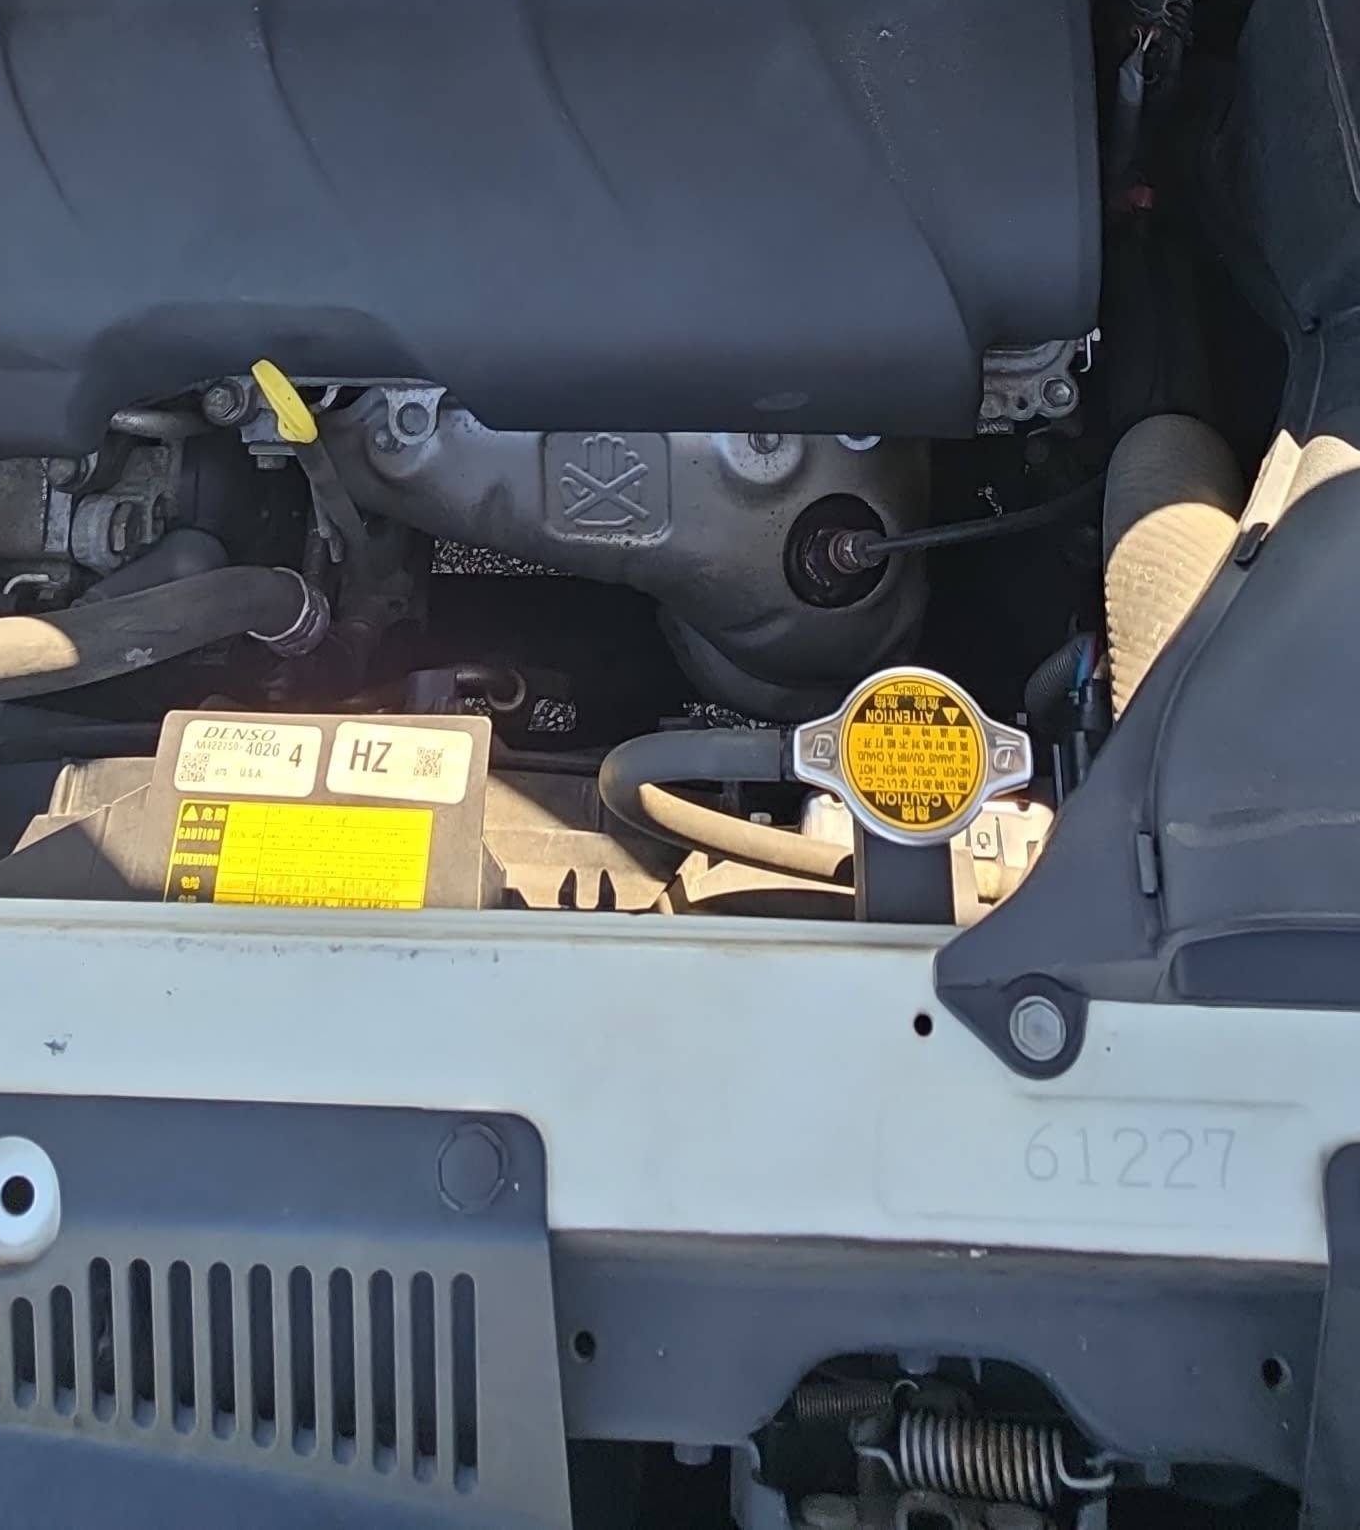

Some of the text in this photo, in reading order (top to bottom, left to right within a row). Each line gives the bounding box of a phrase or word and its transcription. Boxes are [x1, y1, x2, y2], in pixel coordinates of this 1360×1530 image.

[865, 709, 935, 724] ATTENTION
[203, 726, 276, 742] DENSO
[288, 743, 303, 767] 4
[349, 739, 393, 774] HZ
[897, 751, 925, 763] OUVRIR
[929, 752, 956, 764] JAMAIS
[883, 765, 907, 776] WHEN
[913, 766, 937, 776] OPEN
[943, 767, 971, 777] NEVER
[875, 791, 942, 807] CAUTION
[178, 826, 221, 841] CAUTION
[173, 852, 220, 867] ATTENTION
[1023, 1125, 1237, 1190] 61227
